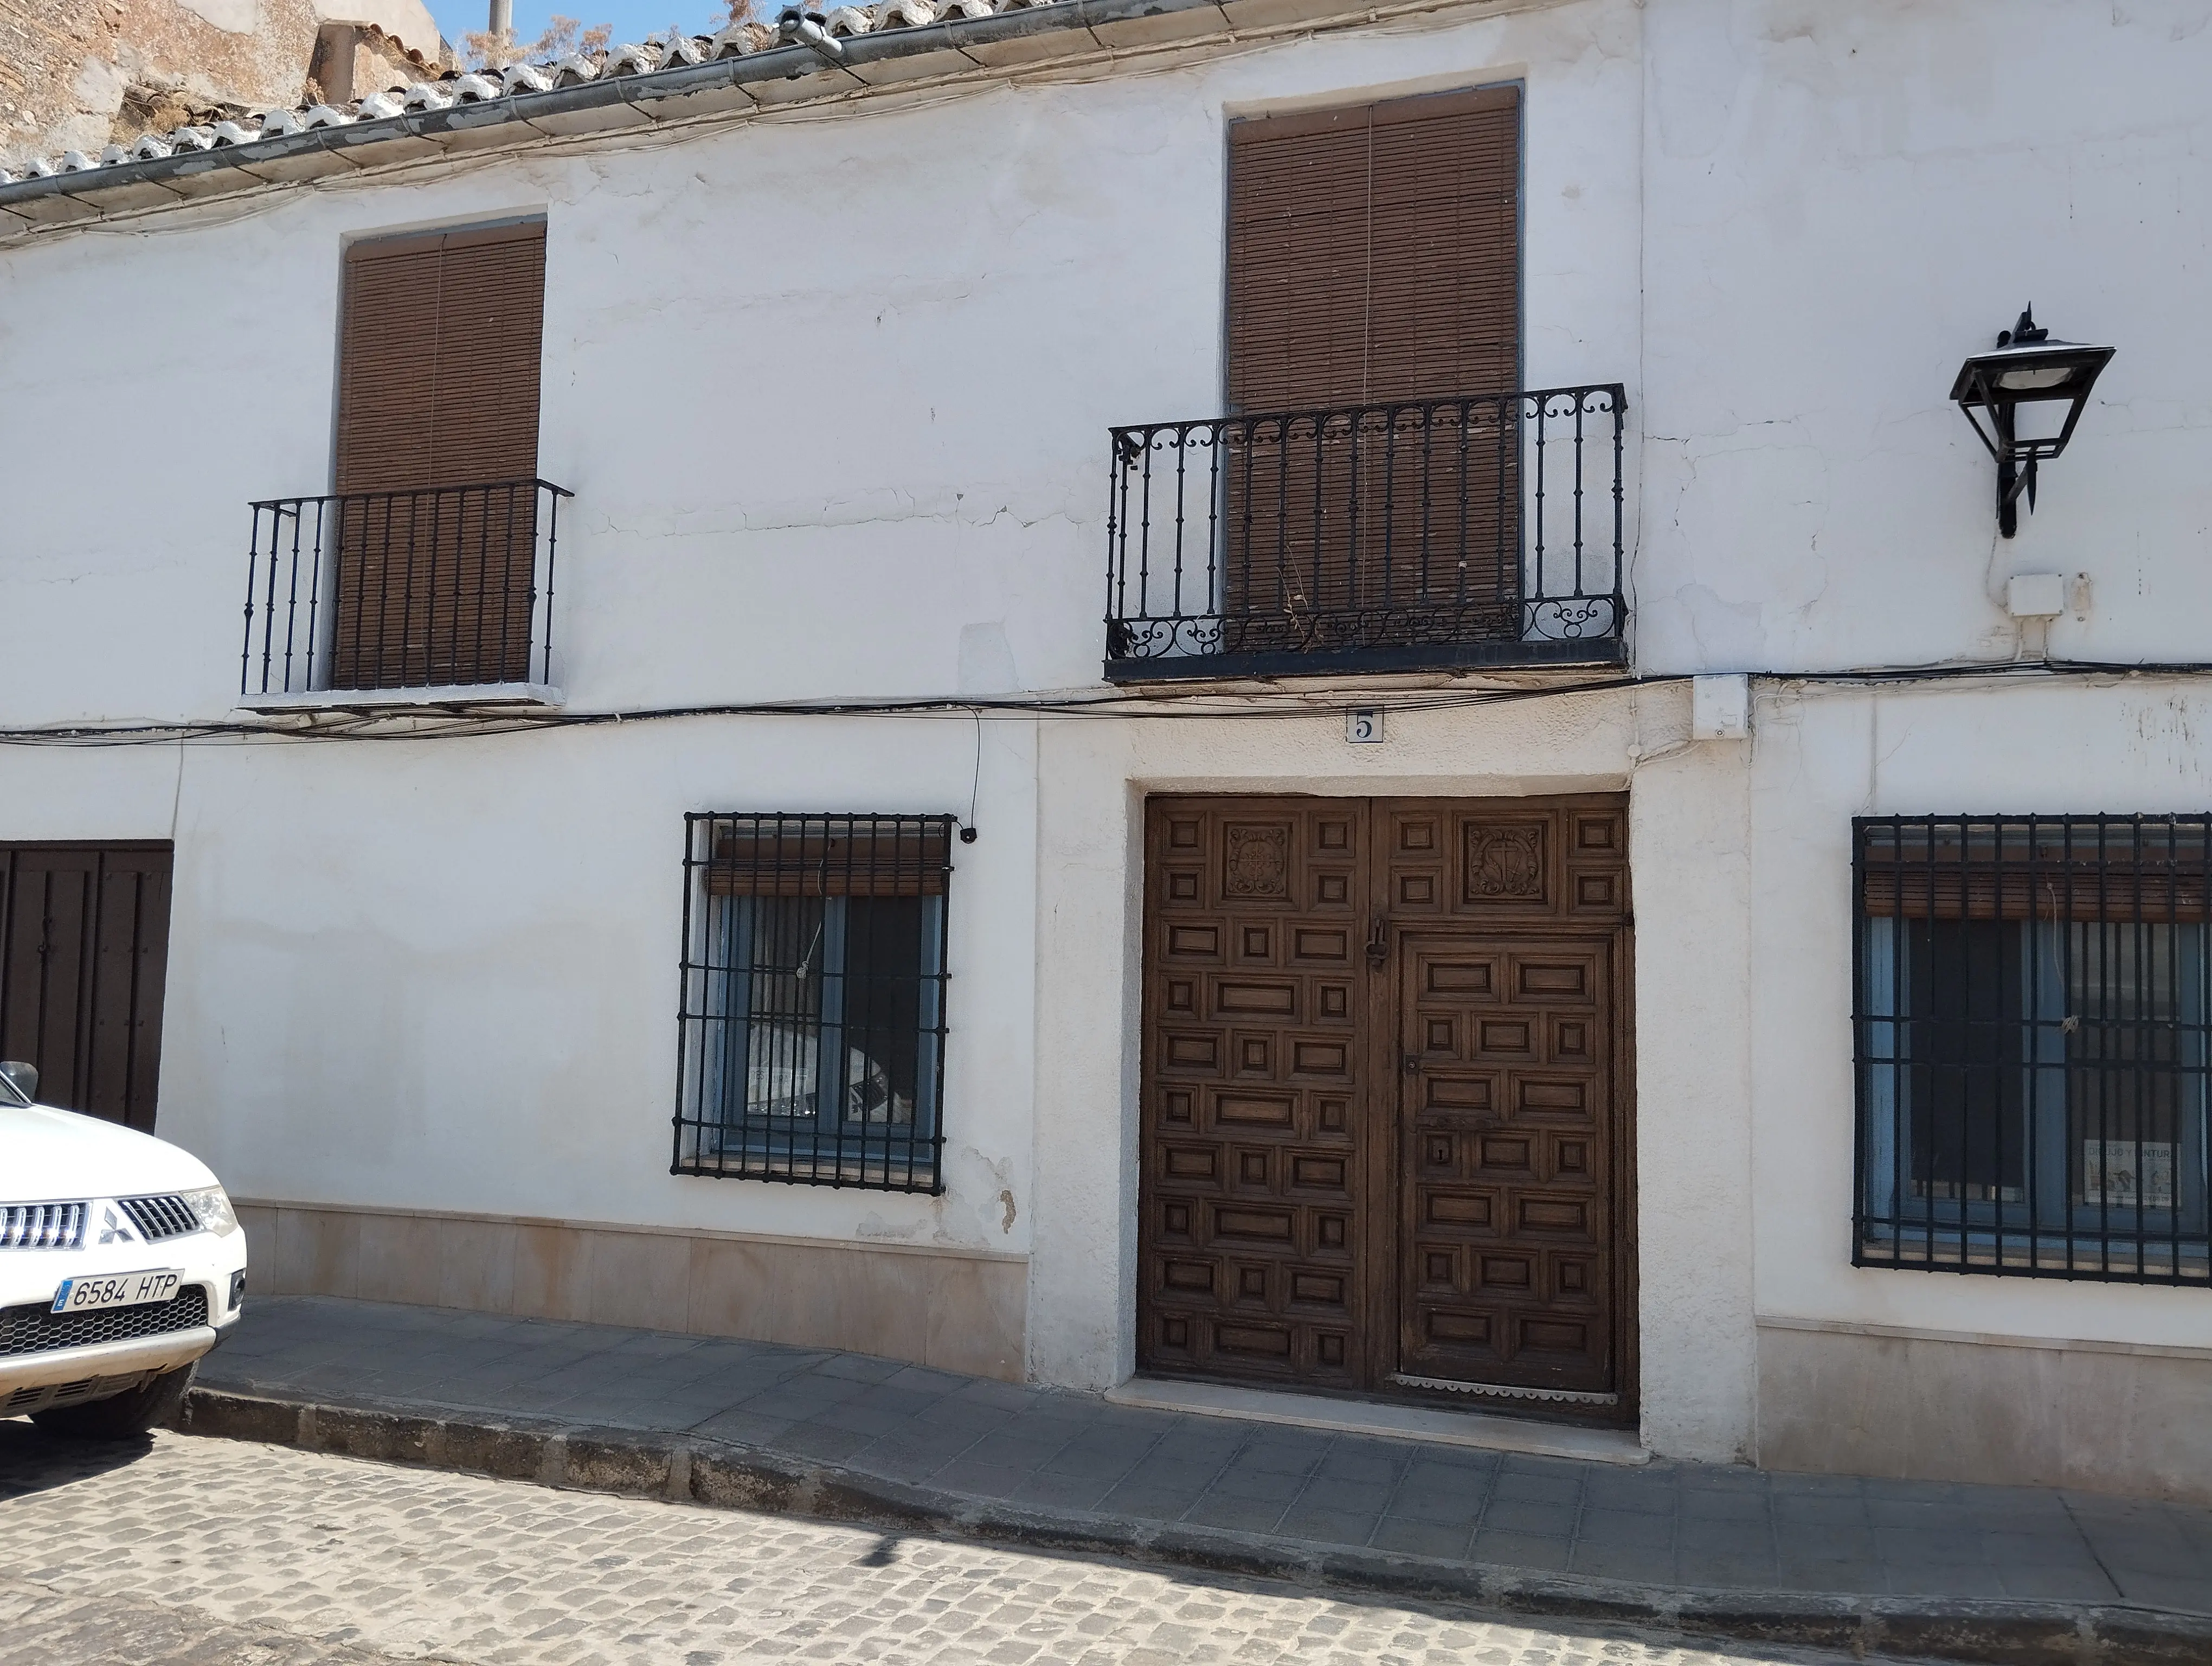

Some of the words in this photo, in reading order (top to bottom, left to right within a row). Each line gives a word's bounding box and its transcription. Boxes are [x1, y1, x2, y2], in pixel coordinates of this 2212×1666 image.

[1356, 711, 1373, 738] 5
[74, 1278, 128, 1305] 6584
[136, 1274, 177, 1300] HTP
